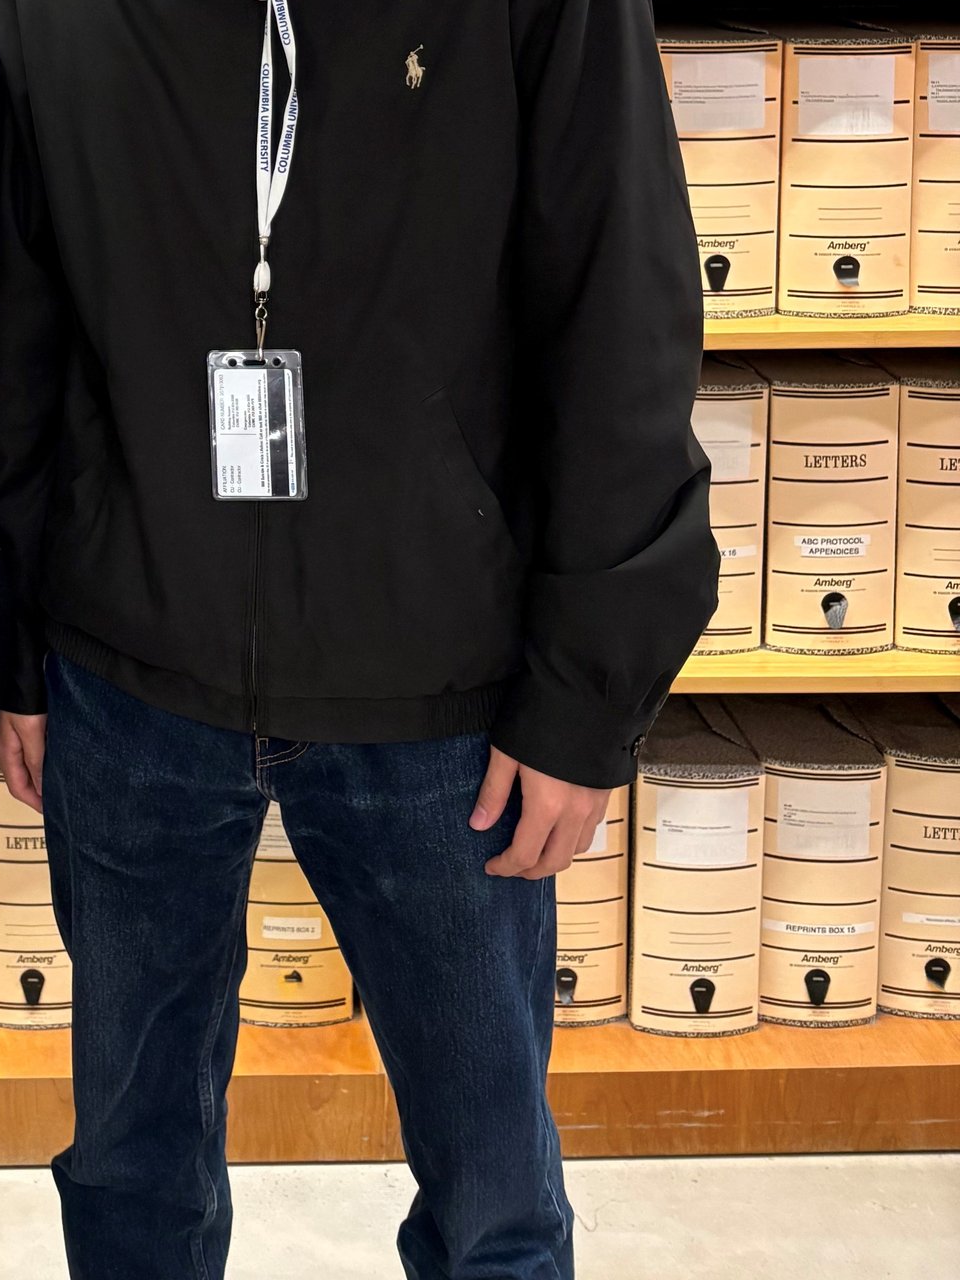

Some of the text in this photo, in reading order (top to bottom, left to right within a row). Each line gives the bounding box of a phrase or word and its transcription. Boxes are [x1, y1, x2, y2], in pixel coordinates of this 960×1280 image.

[260, 63, 269, 172] COLUMBIA UNIVERSITY
[278, 88, 297, 174] COLUMBIA UNIVE
[697, 239, 736, 250] Amberg
[827, 240, 867, 252] Amberg
[804, 454, 867, 468] LETTERS
[801, 536, 864, 546] ABC PROTOCOL
[809, 547, 860, 556] APPENDICES
[814, 578, 852, 588] Amberg
[922, 825, 960, 841] LETT
[6, 836, 47, 851] LETTE
[785, 924, 856, 934] REPRINTS BOX 15
[16, 955, 53, 965] Amberg
[272, 954, 309, 964] Amberg
[801, 953, 839, 965] Amberg
[681, 963, 719, 974] Amberg
